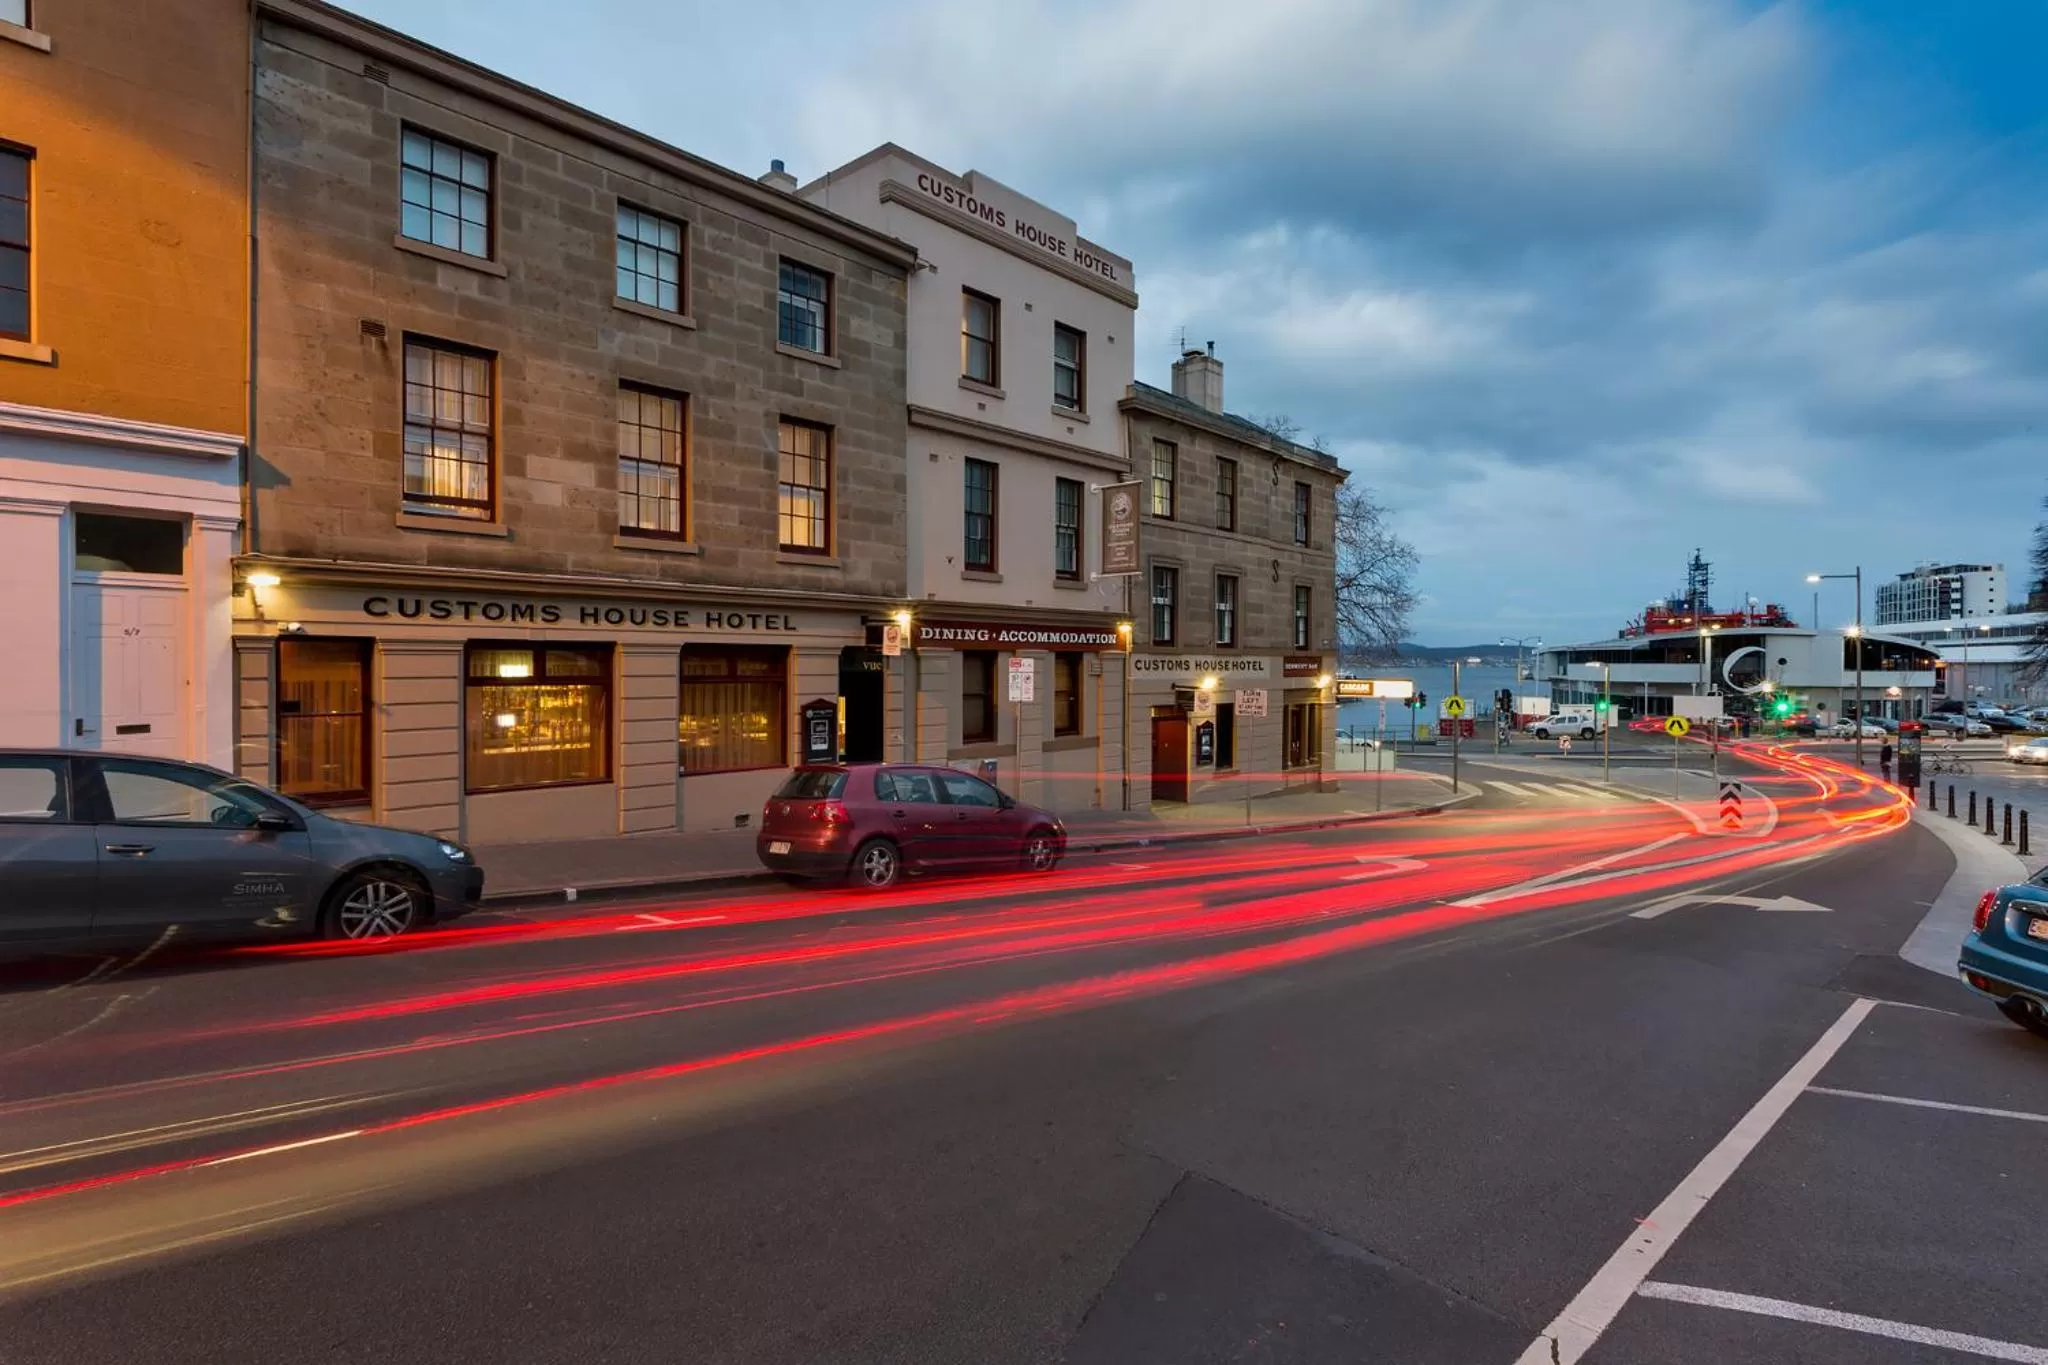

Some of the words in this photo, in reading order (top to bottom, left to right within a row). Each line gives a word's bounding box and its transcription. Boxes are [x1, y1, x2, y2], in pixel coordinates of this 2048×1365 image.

[917, 174, 1006, 228] CUSTOMS
[1015, 219, 1066, 256] HOUSE
[1074, 248, 1117, 281] HOTEL
[363, 596, 561, 623] CUSTOMS
[579, 606, 690, 627] HOUSE
[705, 611, 797, 631] HOTEL
[920, 627, 989, 641] DINING
[998, 630, 1117, 644] ACCOMMODATION
[1135, 659, 1190, 671] CUSTOMS
[1195, 660, 1232, 671] HOUSE
[1233, 661, 1264, 671] HOTEL
[233, 882, 285, 895] SIMHA
